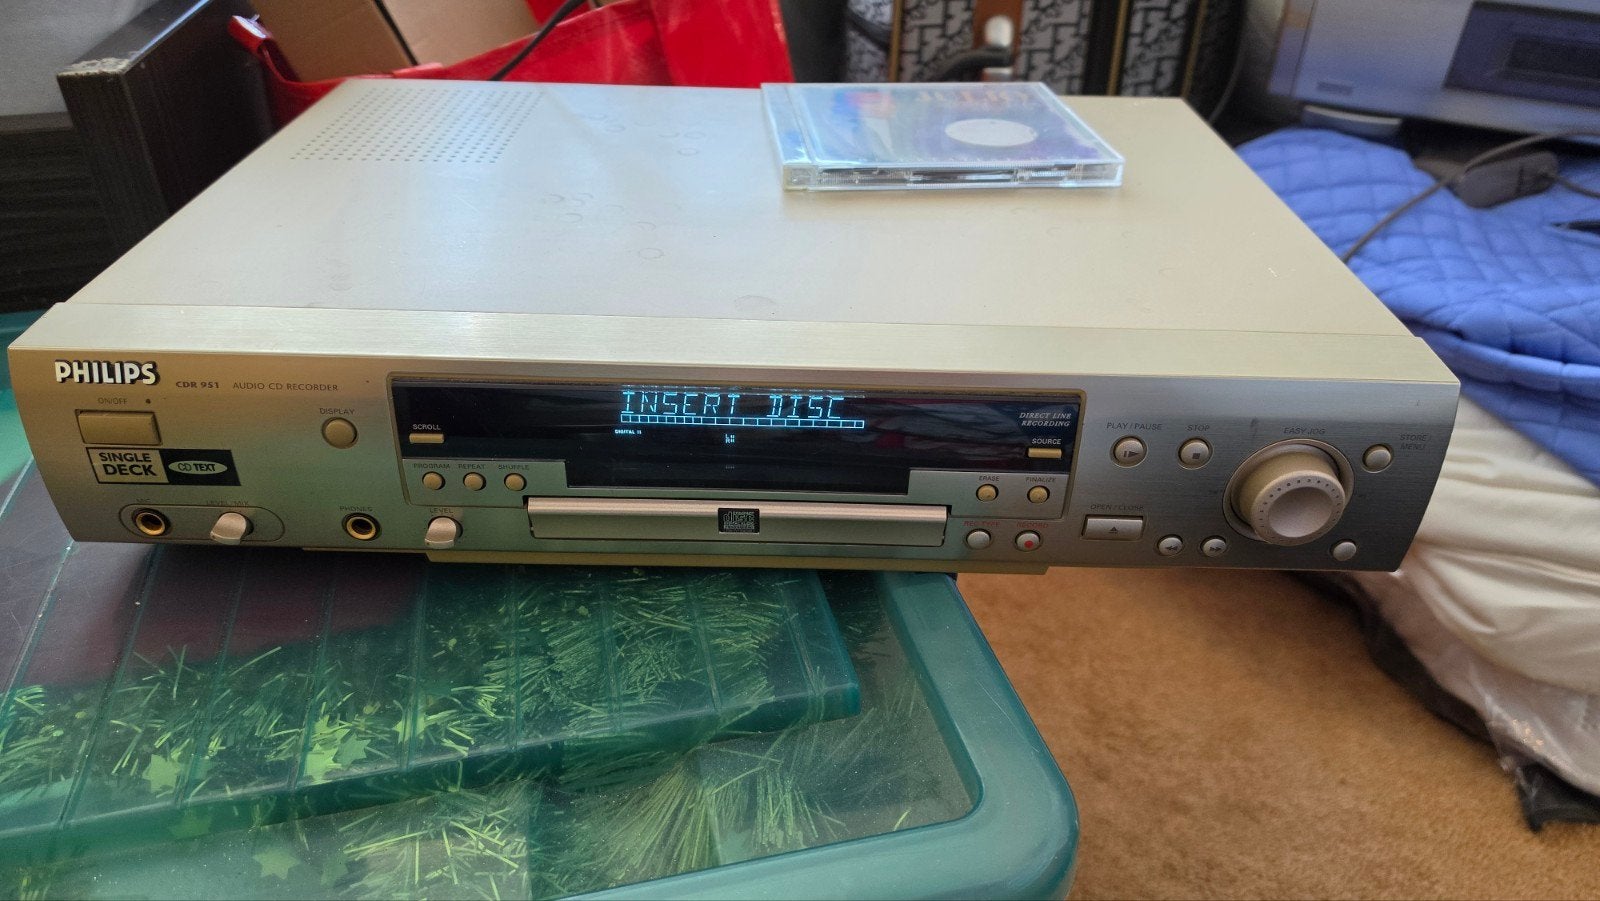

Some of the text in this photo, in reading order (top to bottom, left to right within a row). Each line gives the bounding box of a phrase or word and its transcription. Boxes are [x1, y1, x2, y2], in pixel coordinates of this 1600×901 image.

[54, 359, 160, 385] PHILIPS
[175, 381, 220, 389] CDR 951
[232, 382, 338, 391] AUDIO CD RECORDER
[97, 397, 128, 405] ON/OFF
[620, 391, 844, 419] INSERT DISC
[319, 407, 354, 415] DISPLAY
[1106, 422, 1128, 430] PLAY
[1134, 423, 1163, 431] PAUSE
[1187, 424, 1211, 432] STOP
[98, 452, 152, 463] SINGLE
[103, 463, 157, 477] DECK
[177, 462, 216, 472] CD TEXT
